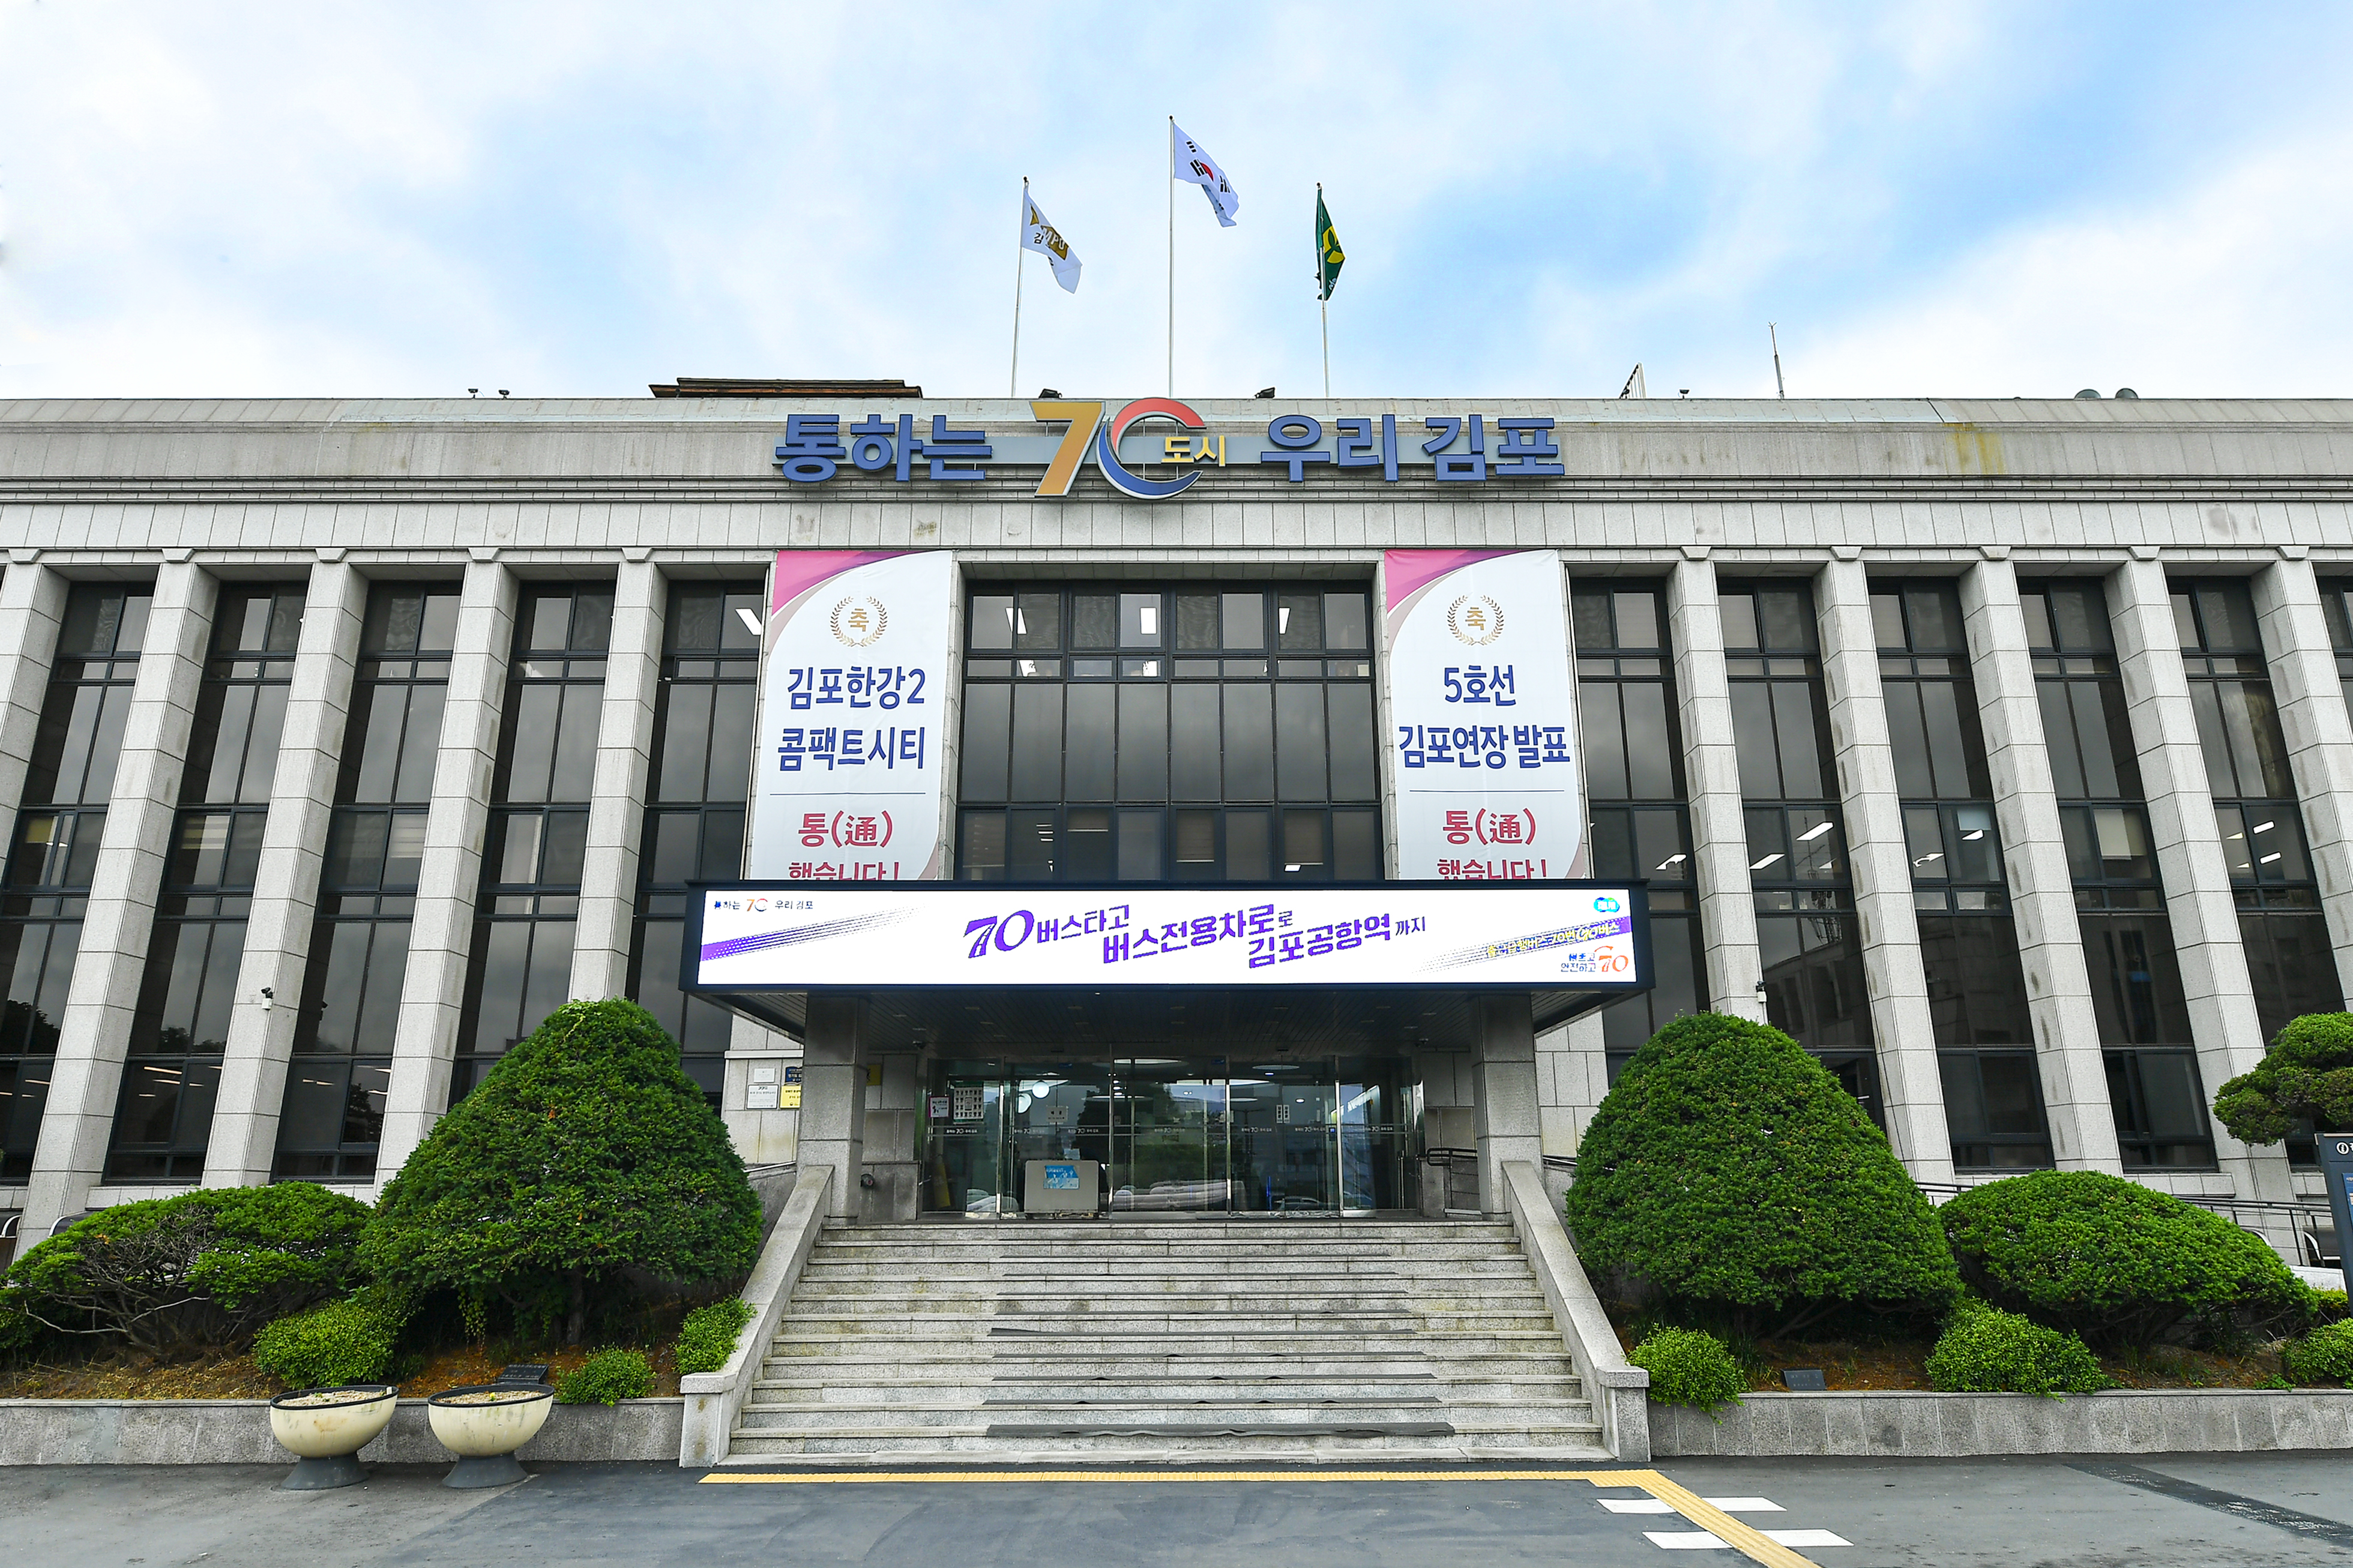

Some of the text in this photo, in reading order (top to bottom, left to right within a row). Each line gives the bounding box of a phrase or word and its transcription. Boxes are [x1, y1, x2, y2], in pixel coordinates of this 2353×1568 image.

[776, 414, 993, 482] 통하는
[1161, 435, 1226, 467] 도시
[1261, 414, 1399, 482] 우리
[1421, 414, 1565, 481] 김포
[848, 608, 869, 632] 축
[1465, 607, 1486, 631] 축
[787, 666, 926, 710] 김포한강2
[1444, 664, 1516, 706] 5호선
[778, 727, 925, 771] 콤팩트시티
[1399, 725, 1570, 769] 김포연장 발표
[798, 810, 893, 848] 통(通)
[1443, 808, 1536, 845] 통(通)
[775, 900, 793, 909] 우리
[1598, 955, 1628, 972] 70
